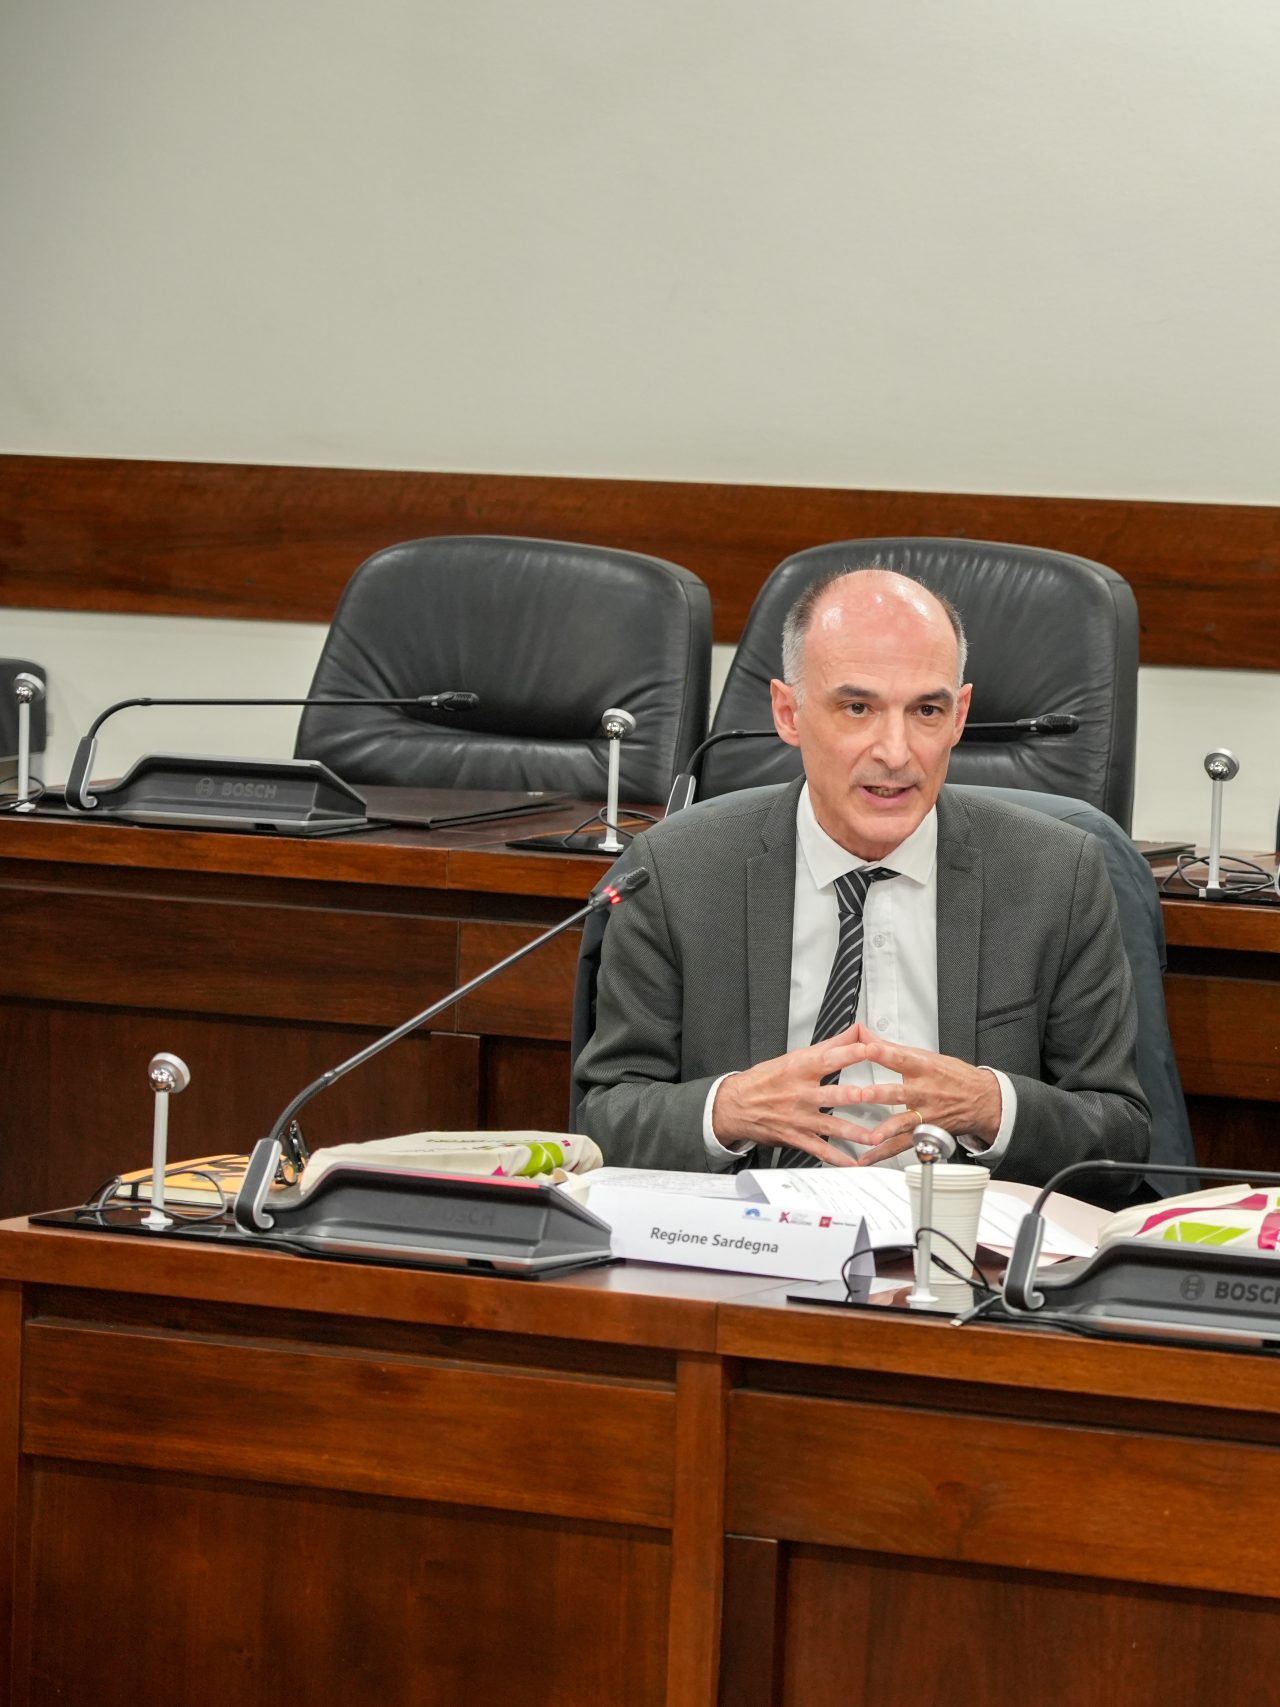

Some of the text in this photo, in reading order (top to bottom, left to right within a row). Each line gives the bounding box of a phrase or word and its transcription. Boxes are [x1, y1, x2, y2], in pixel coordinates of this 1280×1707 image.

[221, 782, 277, 799] BOSCH
[650, 1227, 779, 1255] Regione Sardegna
